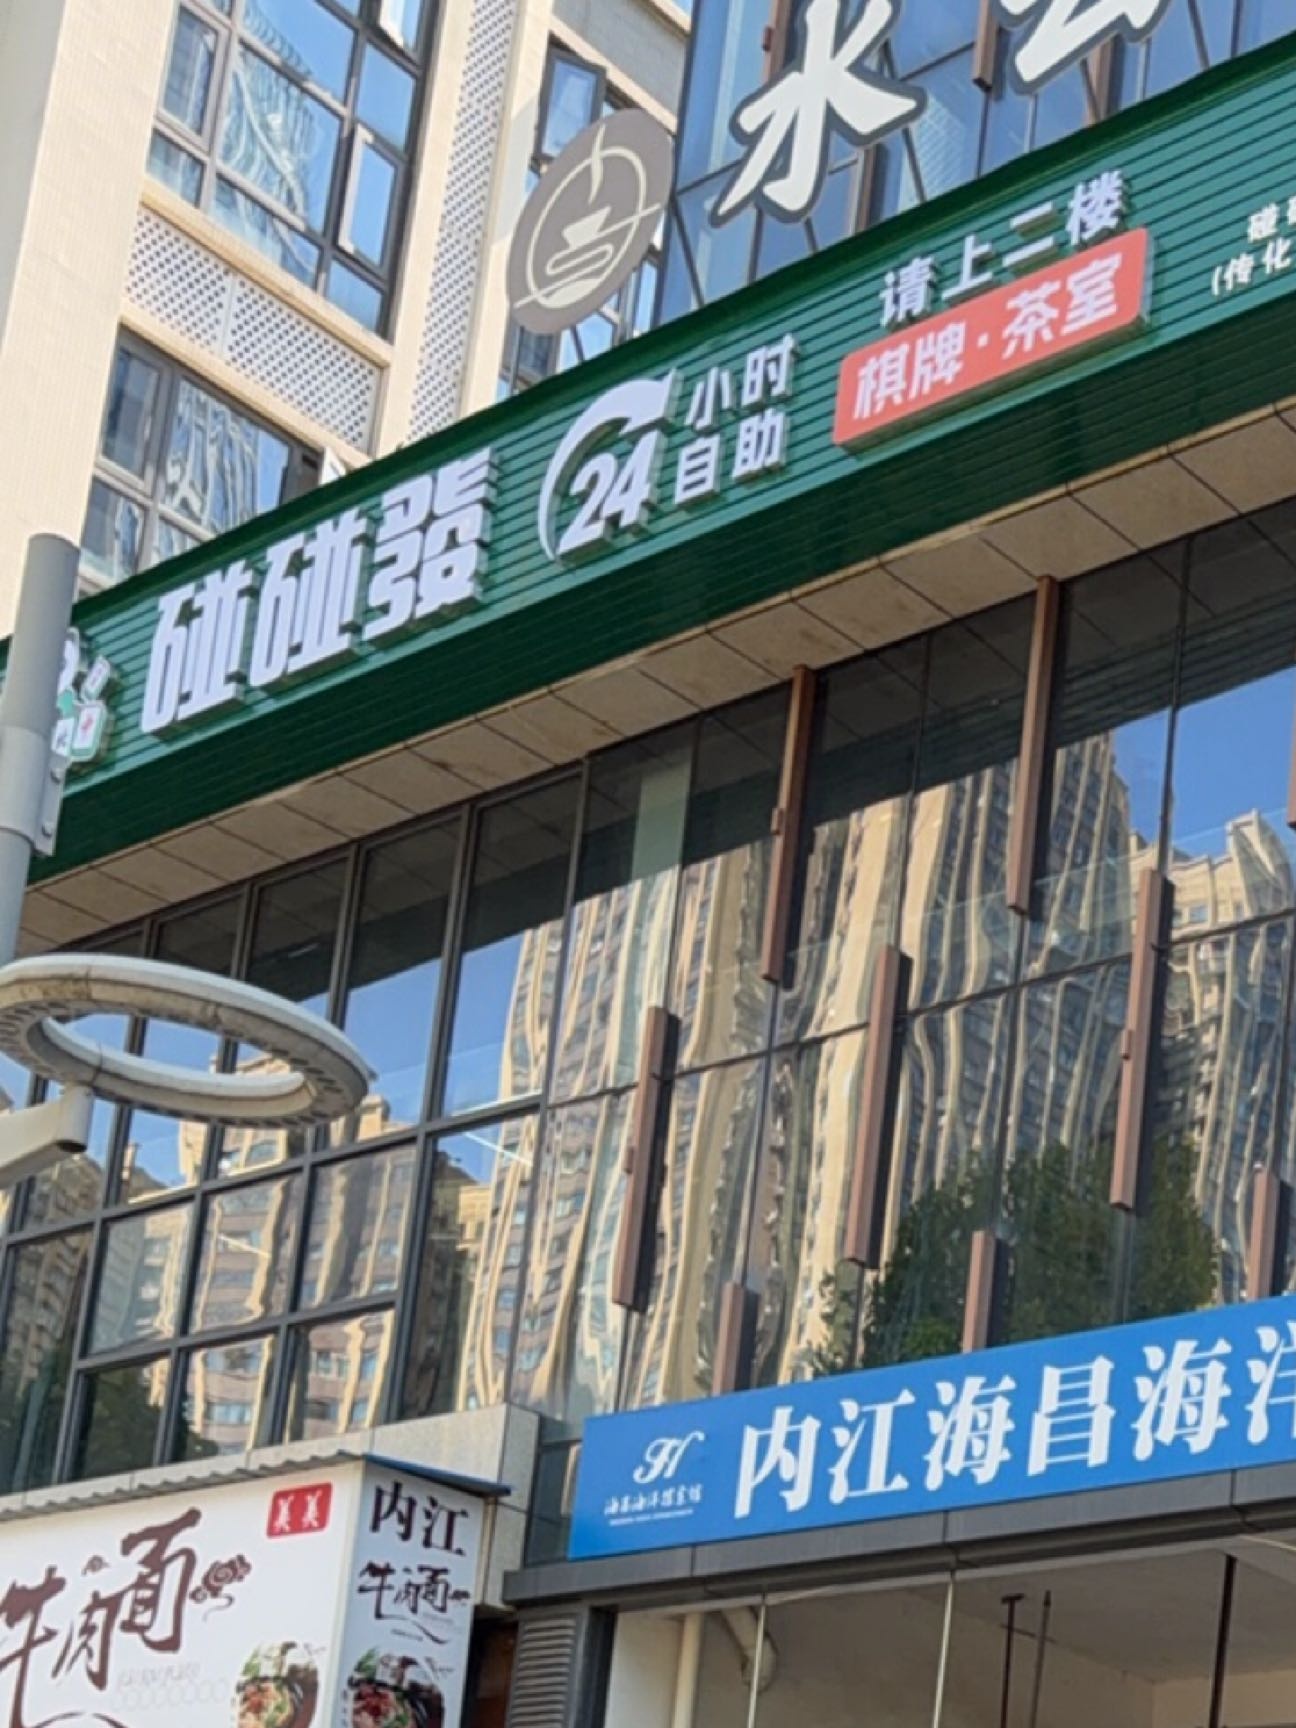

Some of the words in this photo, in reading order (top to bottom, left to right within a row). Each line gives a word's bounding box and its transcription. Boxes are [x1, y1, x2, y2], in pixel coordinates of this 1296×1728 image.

[880, 170, 1123, 328] 请上二楼
[684, 334, 797, 430] 小时
[853, 252, 1123, 420] 棋牌·茶室
[556, 428, 662, 558] 24
[674, 410, 789, 504] 自助
[369, 1480, 469, 1556] 内江
